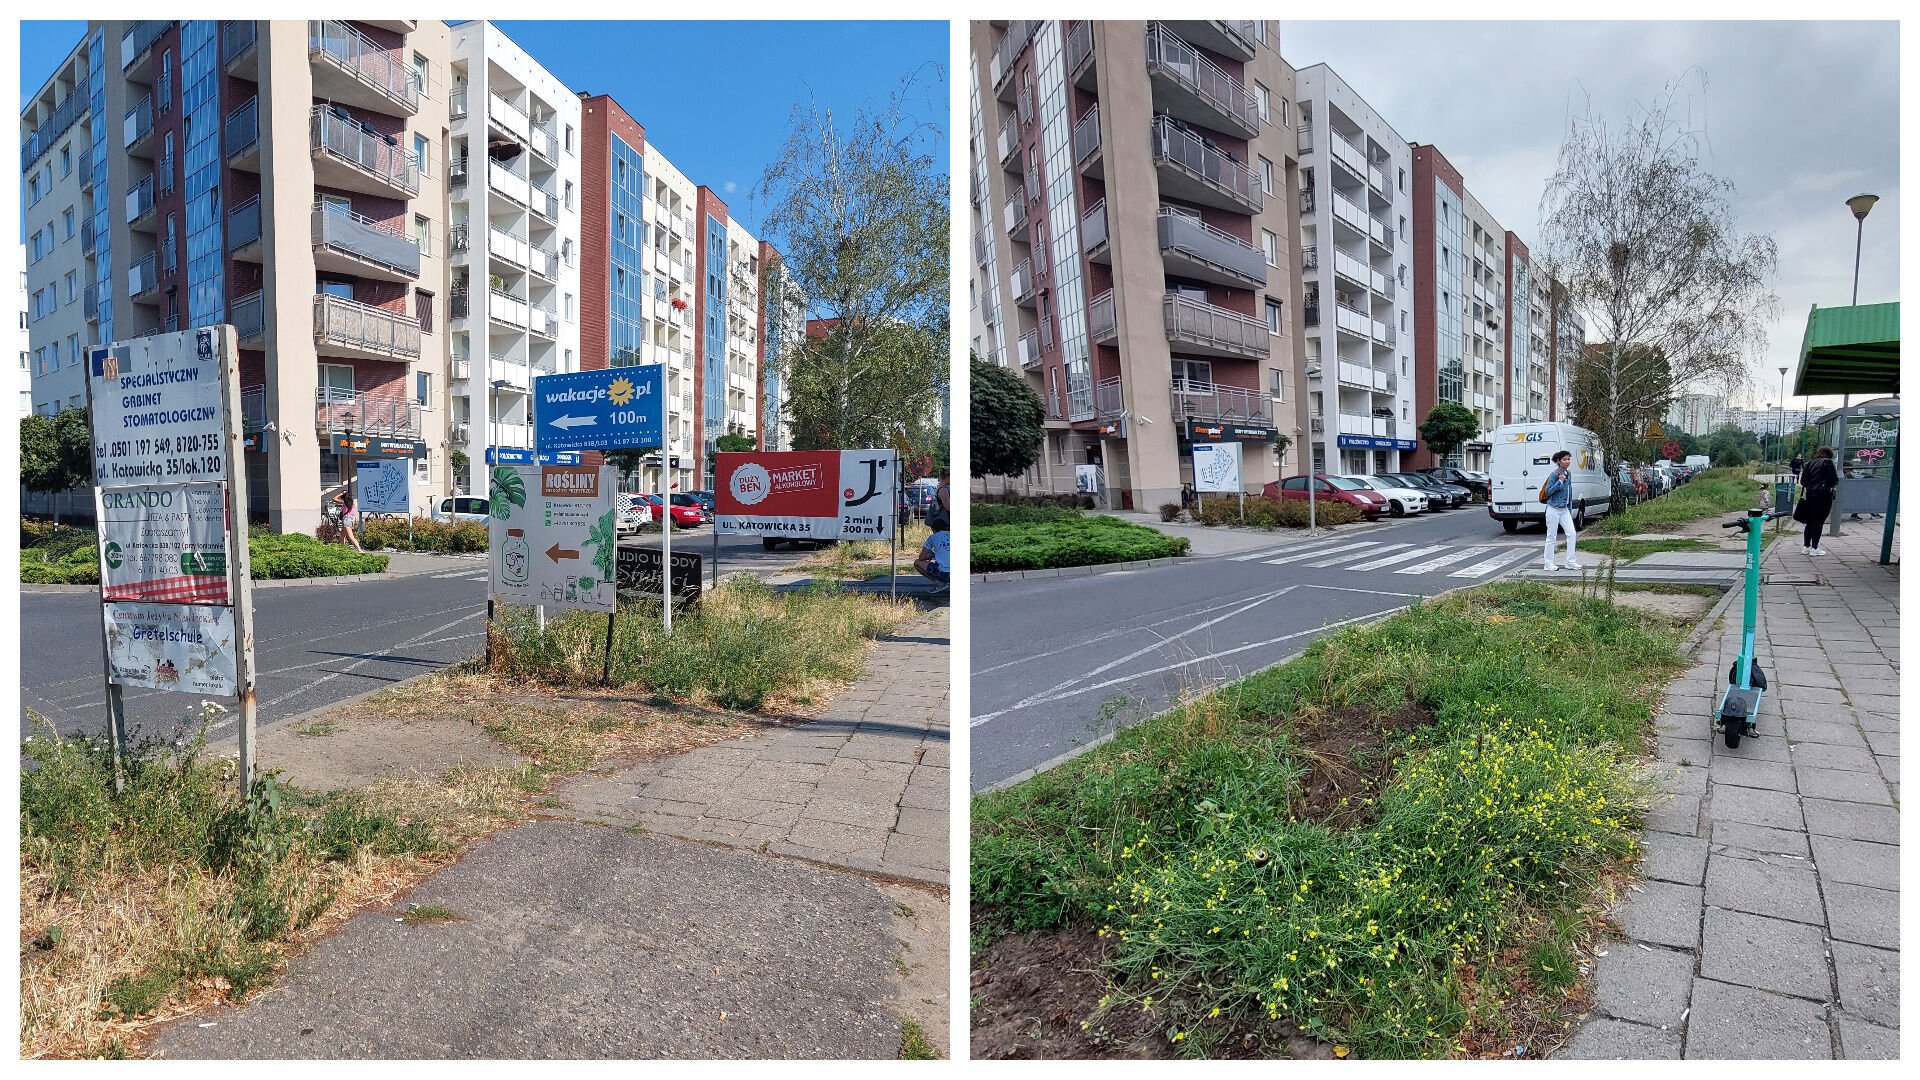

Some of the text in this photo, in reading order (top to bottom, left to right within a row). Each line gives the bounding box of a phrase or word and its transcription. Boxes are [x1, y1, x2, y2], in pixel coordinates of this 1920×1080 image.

[120, 367, 199, 390] SPECJALISTYCZNY
[122, 392, 162, 409] GABINET
[123, 406, 216, 428] STOMATOLOGICZNY
[610, 411, 647, 426] 100m
[136, 438, 150, 456] 197
[176, 433, 219, 453] 8720-755
[1526, 432, 1543, 442] GLS
[553, 441, 582, 449] Katowicka
[98, 465, 109, 479] ul.
[112, 460, 163, 479] Katowicka
[772, 468, 817, 483] MARKET
[546, 471, 596, 489] ROŚLINY
[739, 474, 760, 484] DUŻY
[774, 479, 817, 490] ALKOHOLOWY
[740, 482, 761, 493] BEN
[102, 490, 173, 510] GRANDO
[164, 513, 170, 522] &
[171, 512, 192, 522] PASTA
[844, 515, 873, 525] 2 min
[722, 521, 811, 532] UL. KATOWICKA 35
[842, 525, 862, 534] 300
[618, 551, 698, 568] UDIO UODY
[1746, 553, 1754, 570] Bolt
[113, 609, 145, 620] Centrum
[133, 625, 203, 644] Gretelschule
